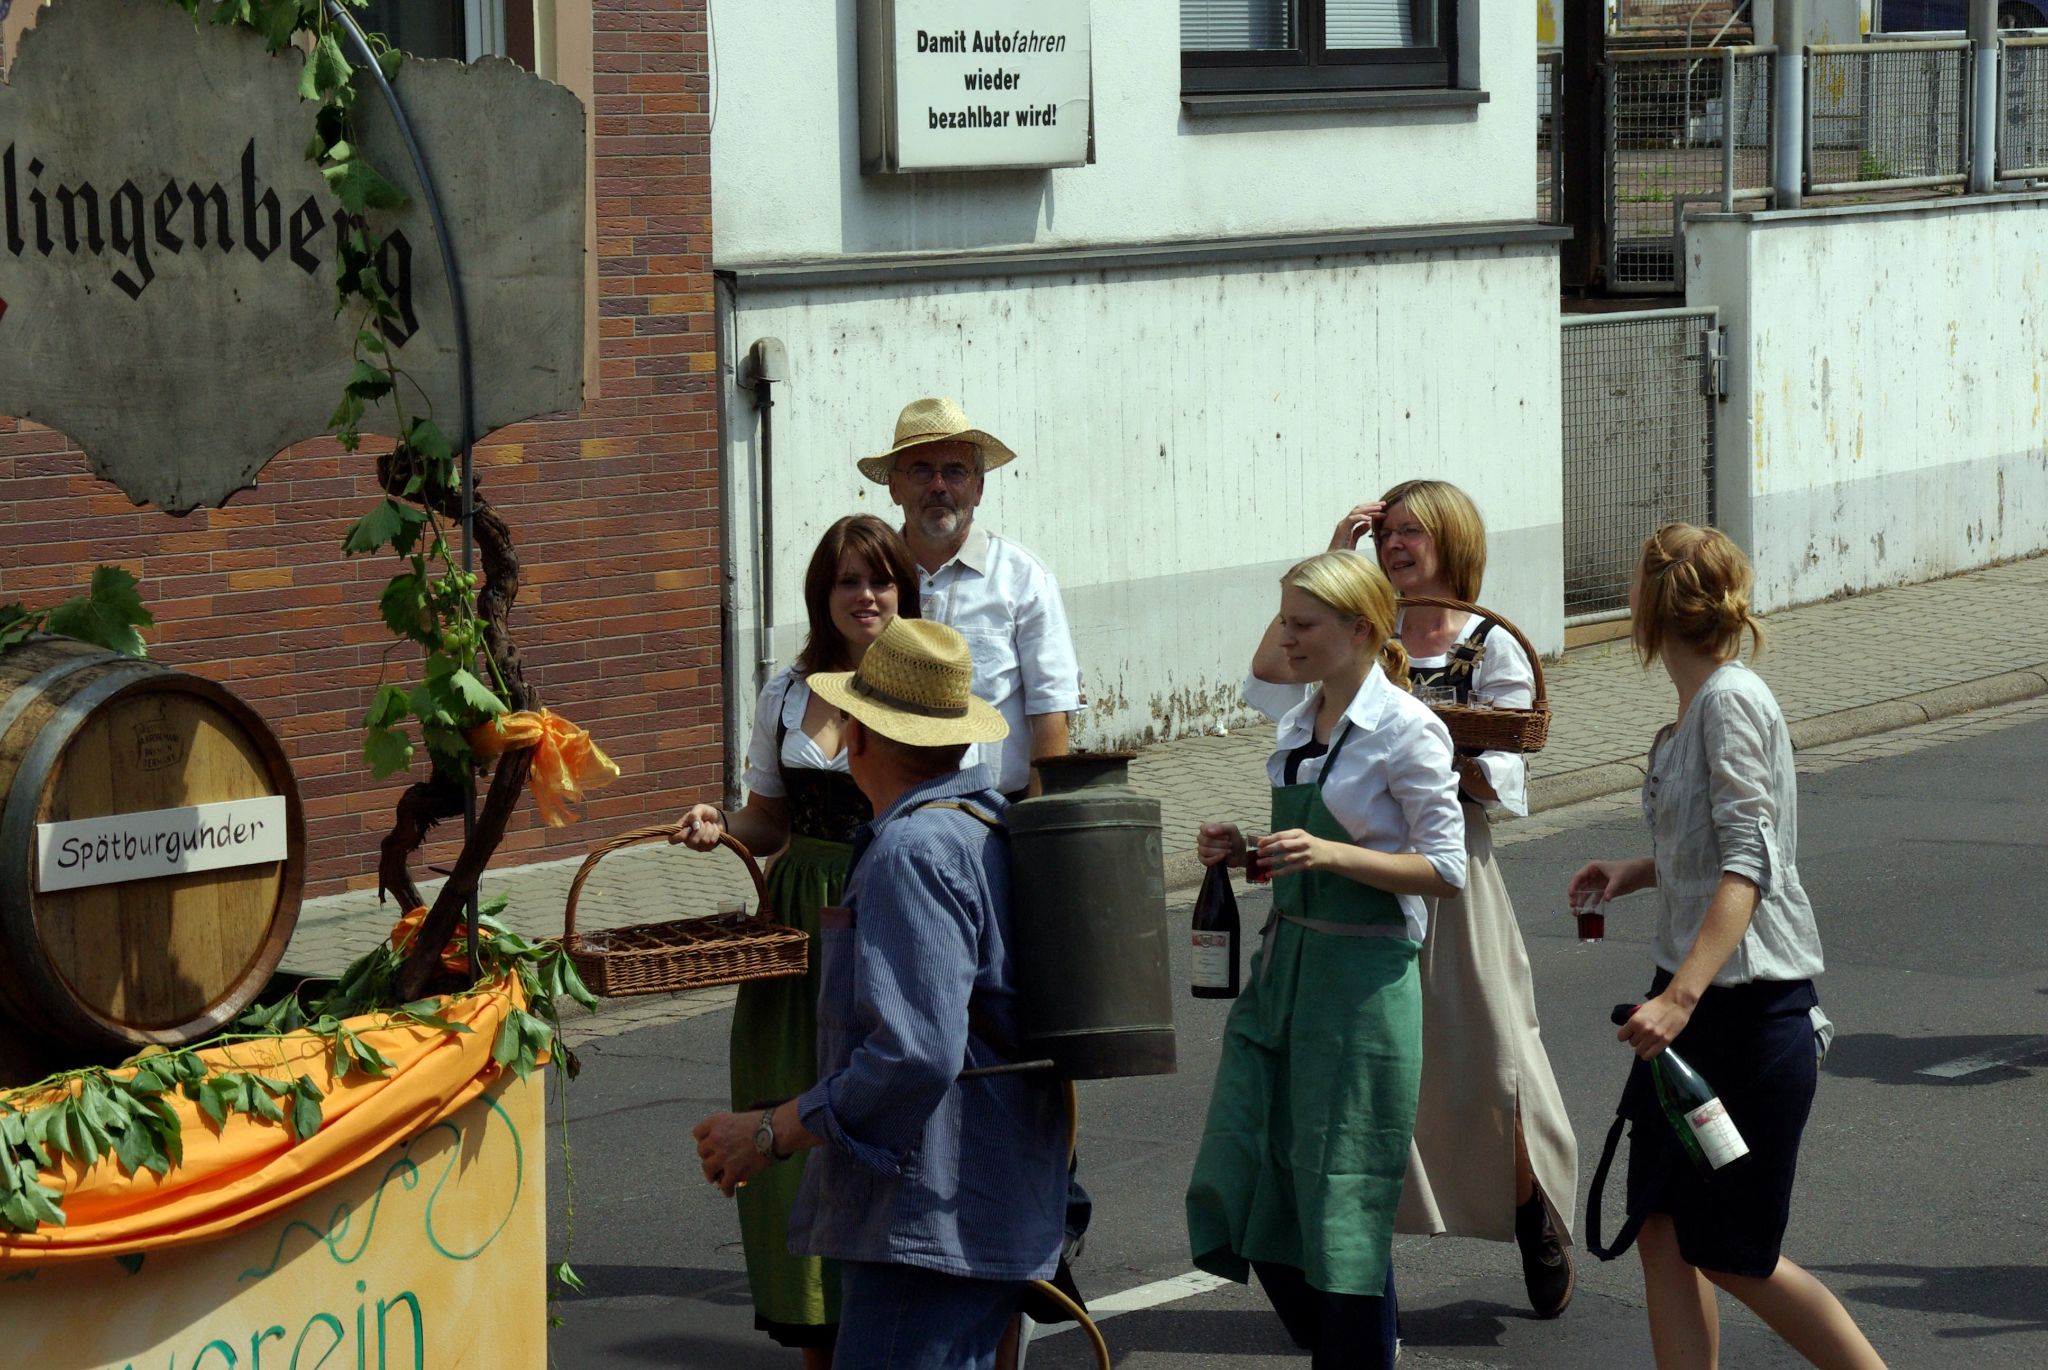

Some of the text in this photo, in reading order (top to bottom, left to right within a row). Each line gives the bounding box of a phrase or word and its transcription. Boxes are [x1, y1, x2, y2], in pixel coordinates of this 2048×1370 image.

[916, 29, 1066, 53] Damit Autofahren
[964, 67, 1020, 91] wieder
[928, 104, 1057, 129] bezahlbar wird!
[1, 137, 420, 349] lingenberg
[57, 813, 264, 870] Spätburgunder
